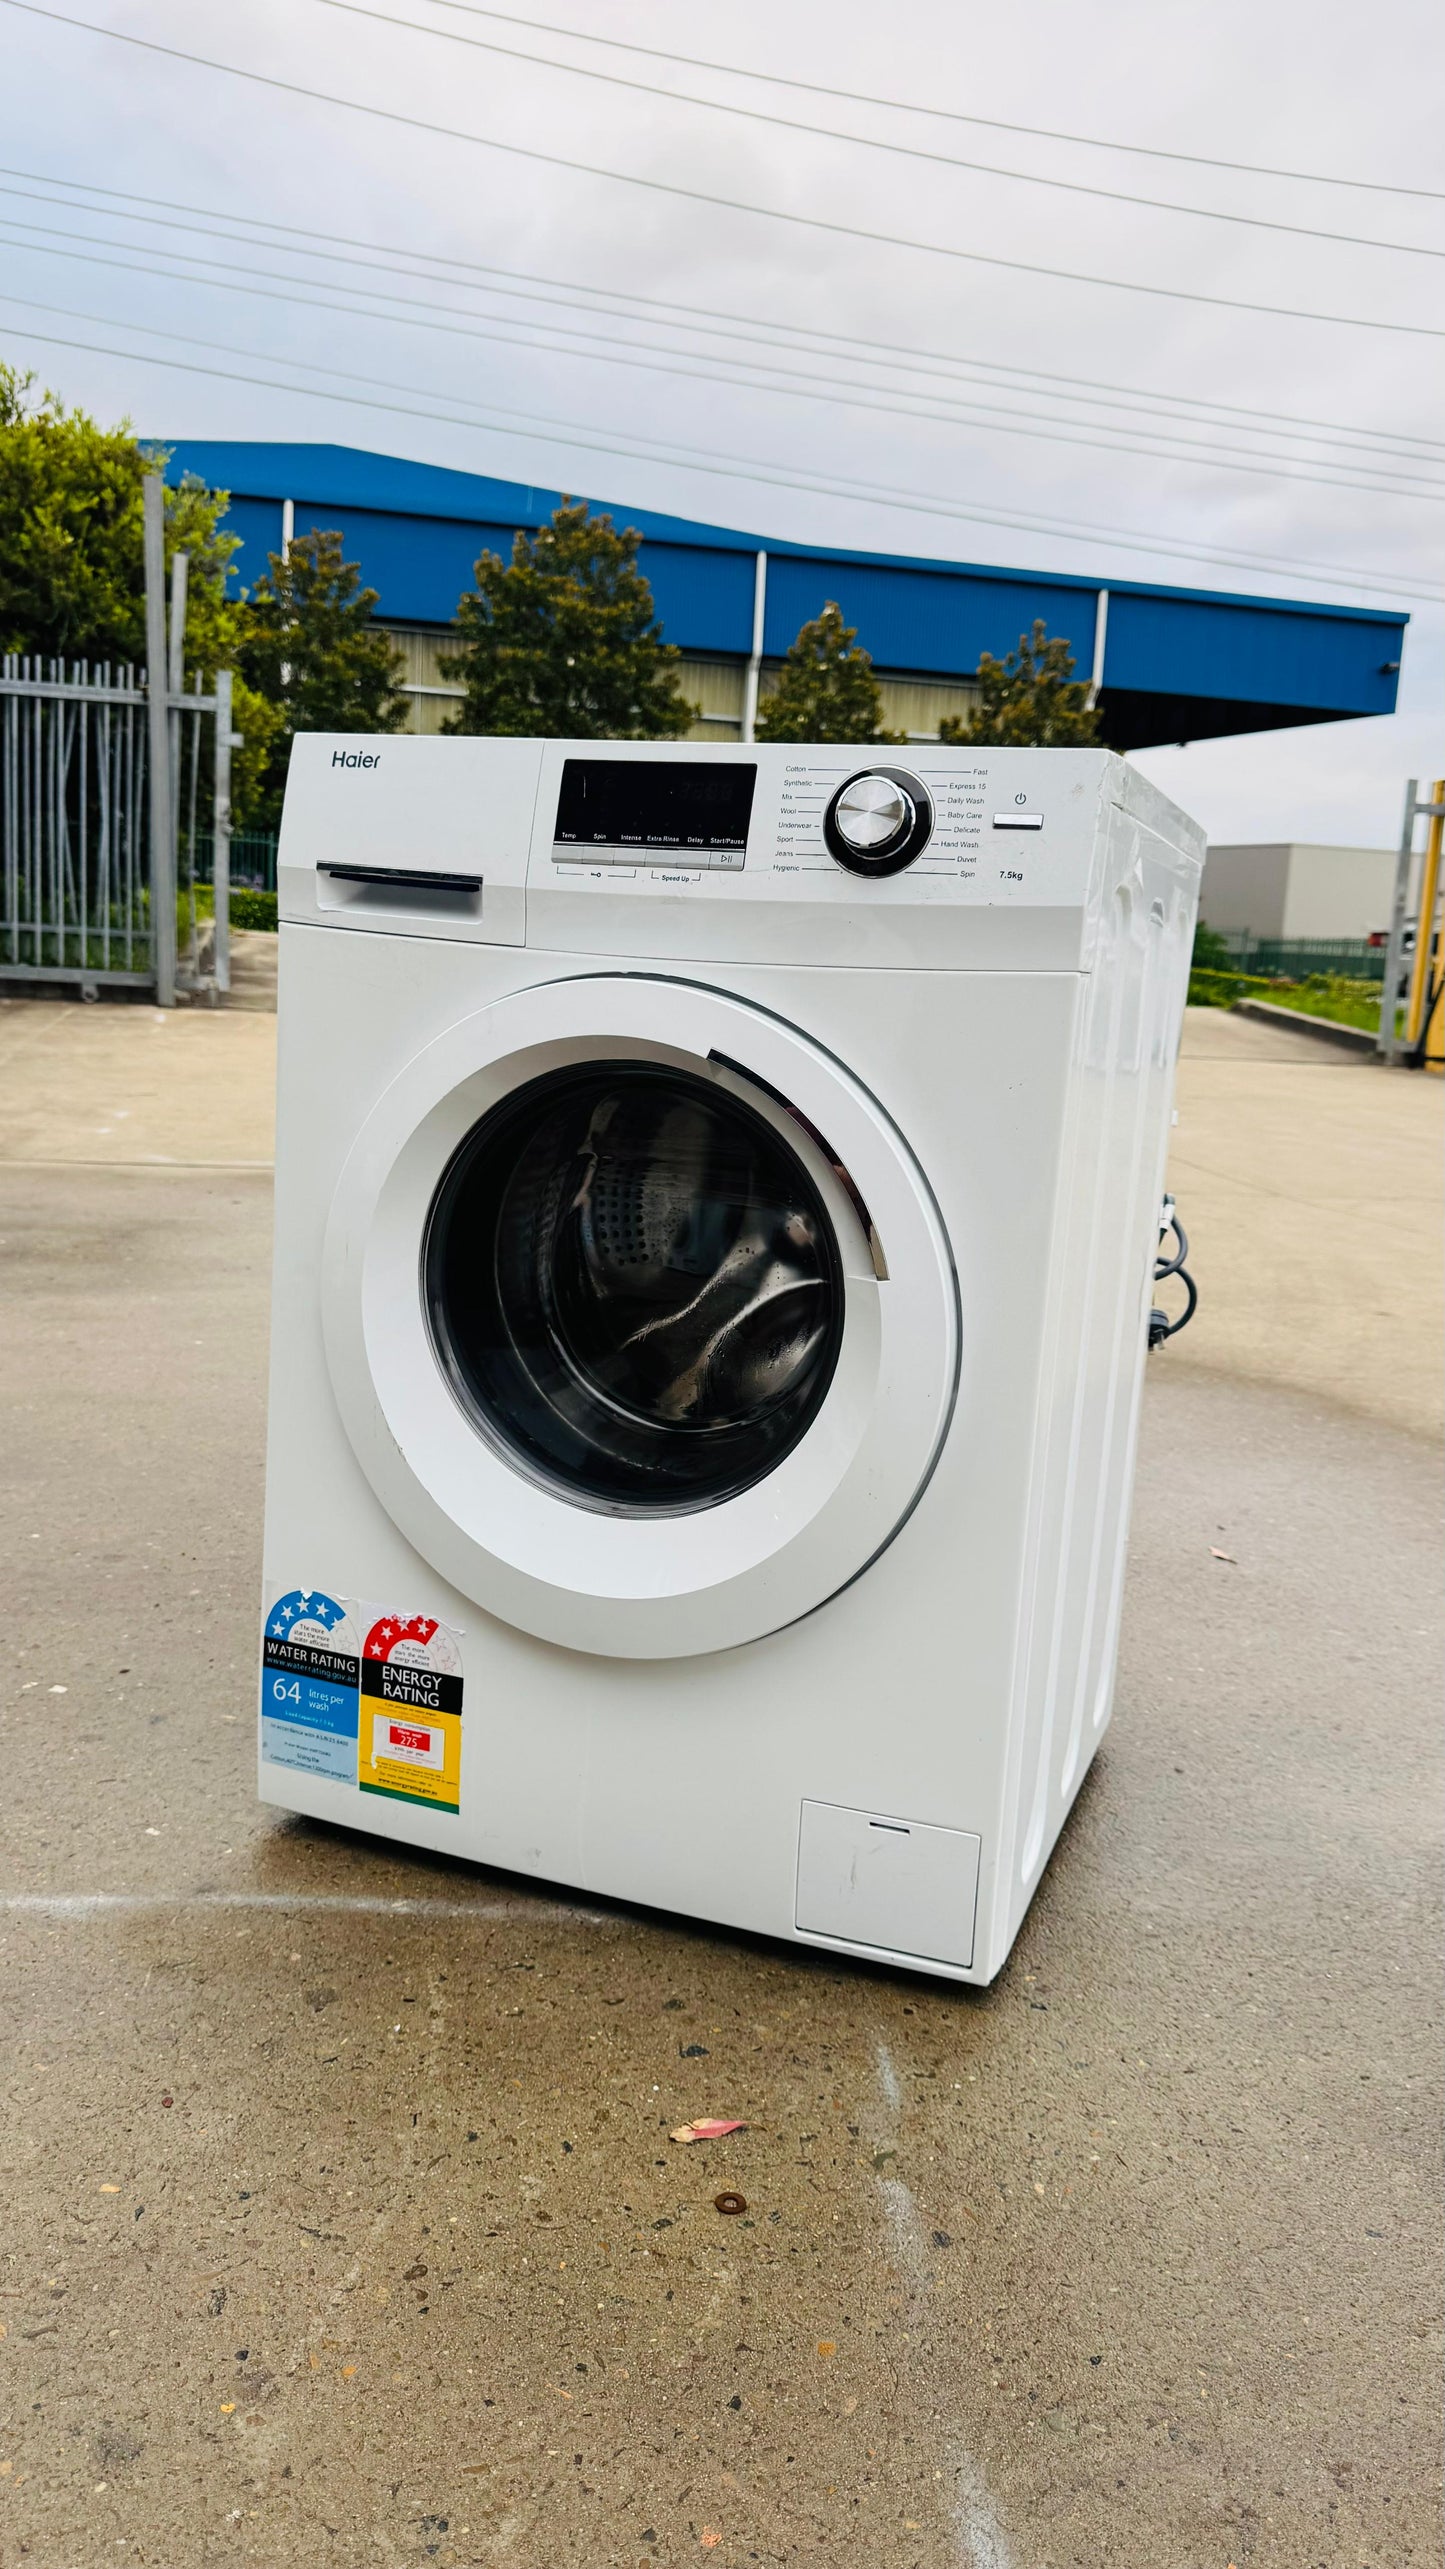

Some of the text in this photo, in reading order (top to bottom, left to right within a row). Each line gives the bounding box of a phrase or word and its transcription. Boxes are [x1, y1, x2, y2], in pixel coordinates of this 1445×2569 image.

[332, 751, 380, 768] Haier
[1000, 871, 1023, 880] 7.5kg
[267, 1642, 355, 1672] WATER RATING
[267, 1657, 356, 1682] www.waterrating.gov.au
[383, 1666, 442, 1690] ENERGY
[273, 1679, 301, 1704] 64
[309, 1689, 344, 1704] litres per
[384, 1682, 439, 1706] RATING
[309, 1701, 329, 1711] wash
[401, 1735, 417, 1747] 275
